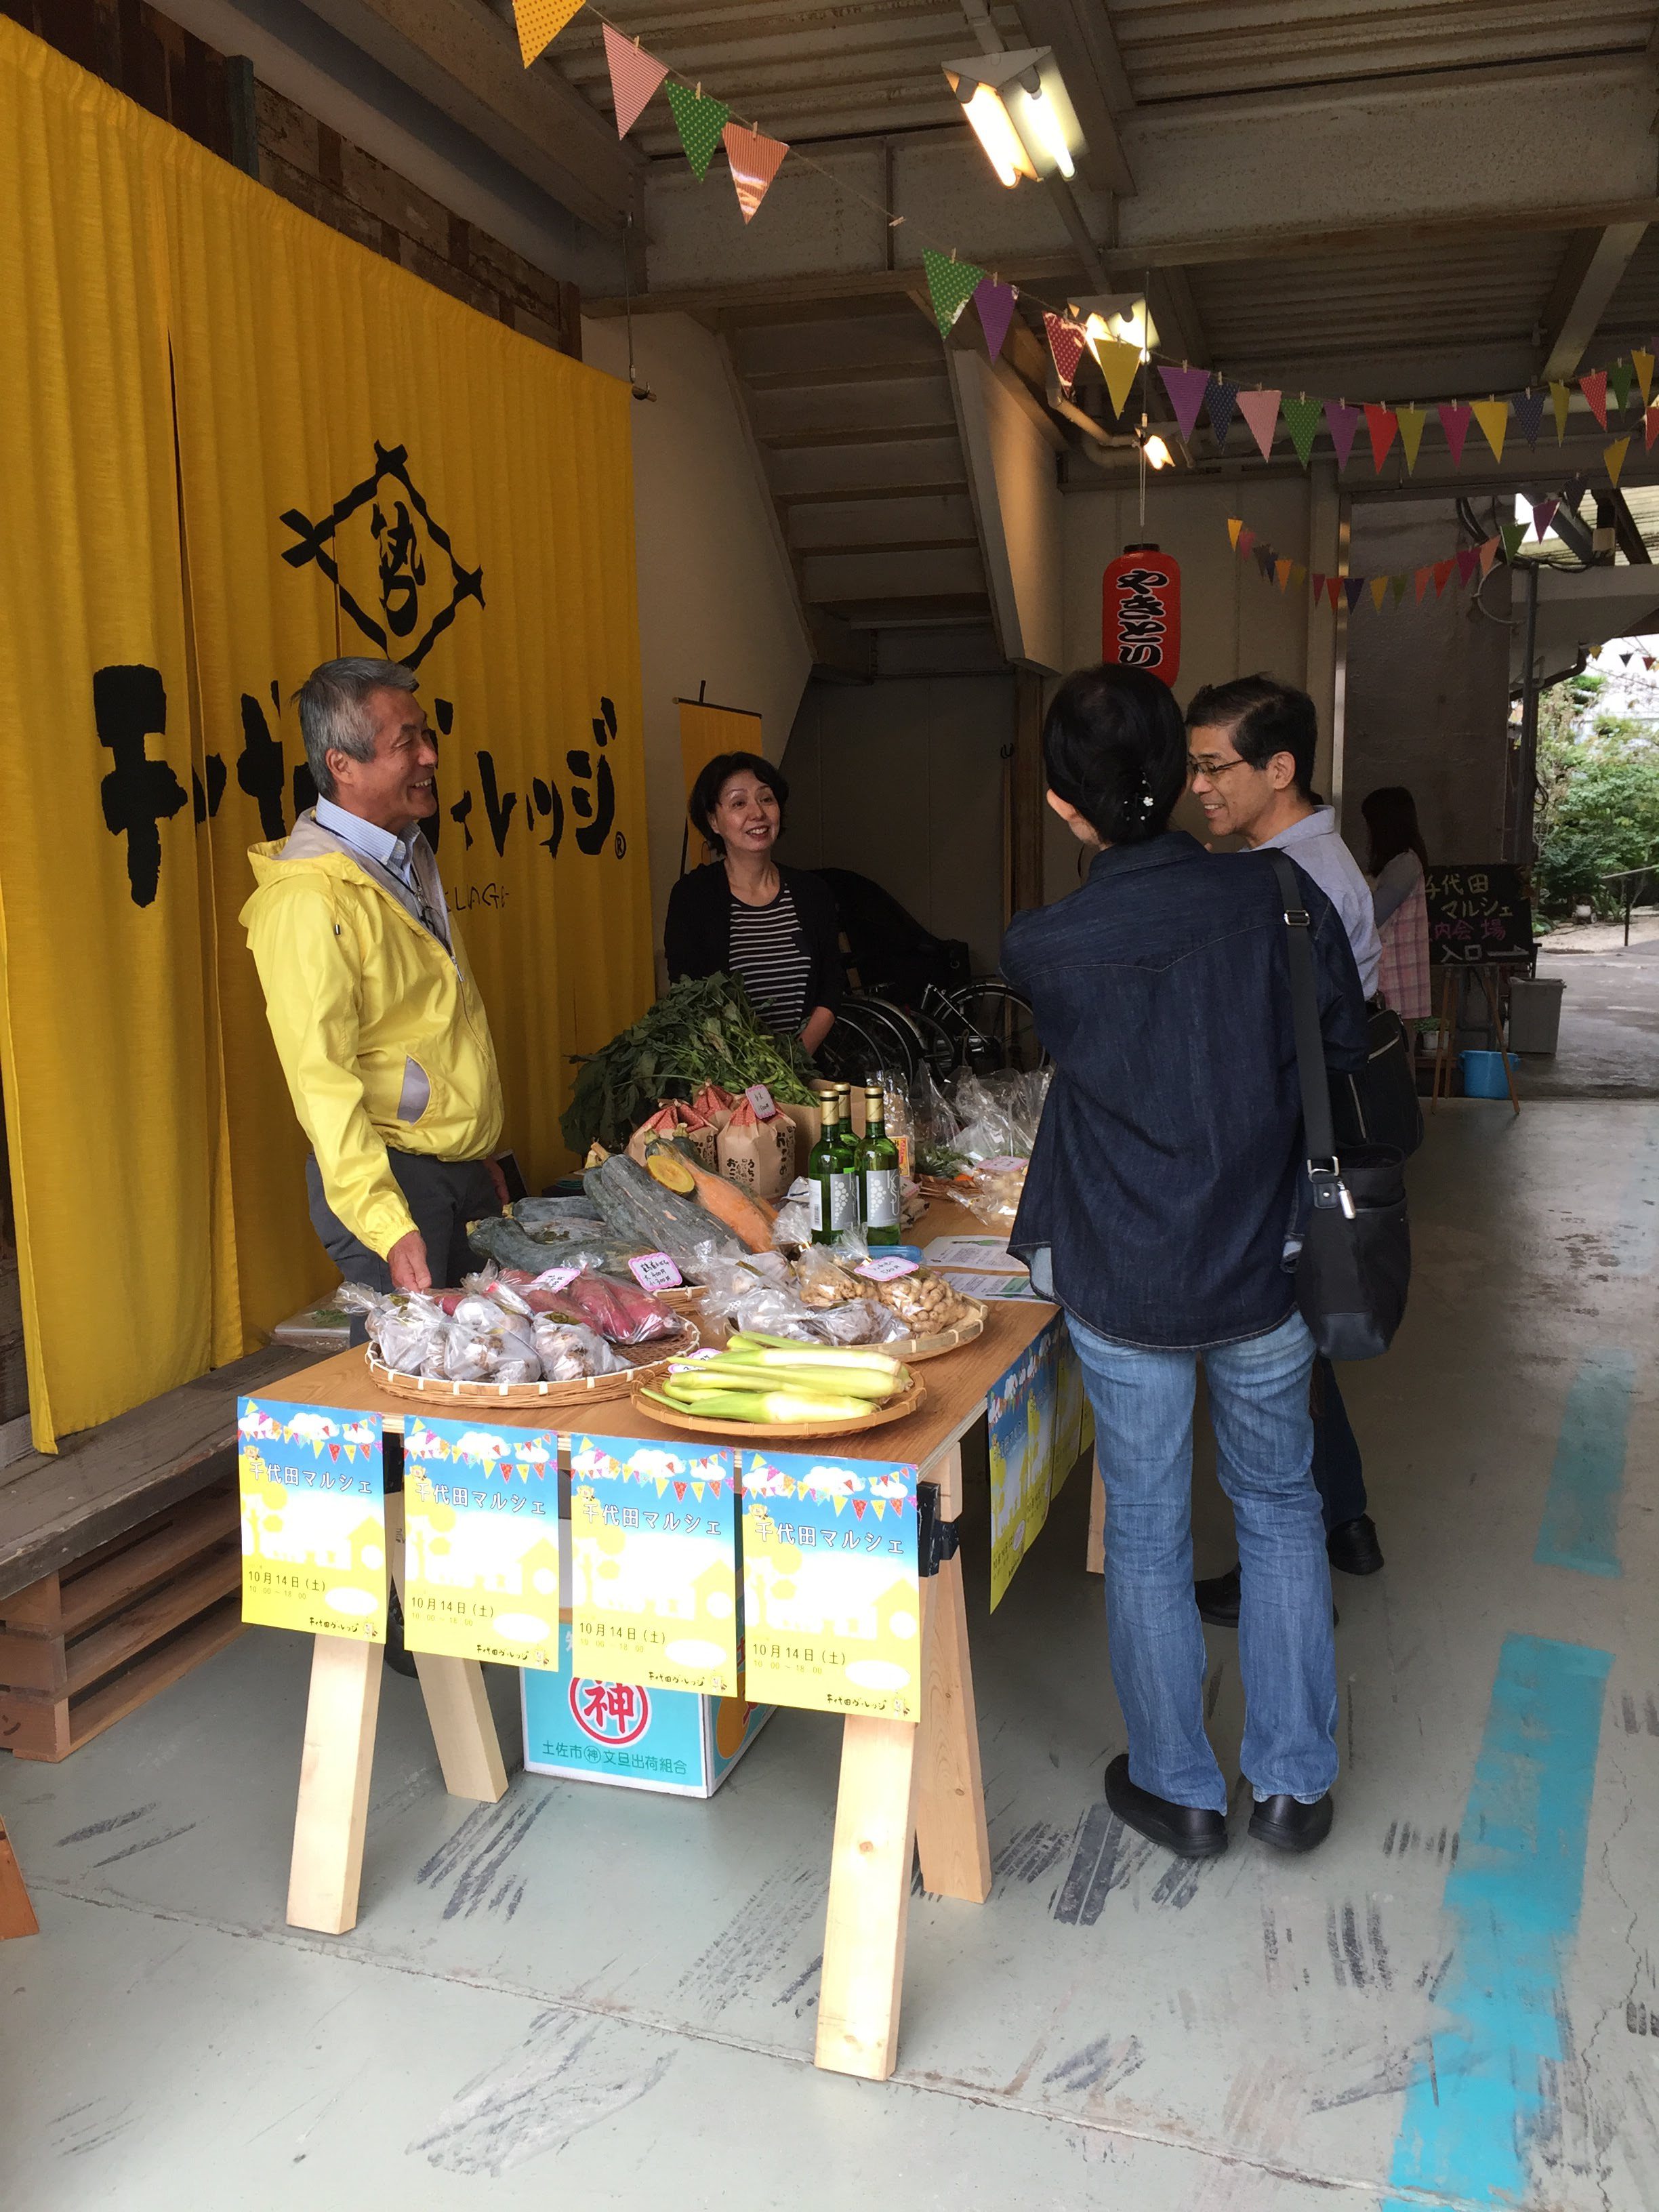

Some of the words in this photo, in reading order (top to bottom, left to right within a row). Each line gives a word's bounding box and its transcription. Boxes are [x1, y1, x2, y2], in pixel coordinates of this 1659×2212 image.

[1116, 568, 1170, 668] やきとり
[1425, 874, 1489, 900] 千代田
[1441, 897, 1513, 919] マルシェ
[1441, 944, 1483, 963] 入口
[249, 1462, 372, 1494] 千代田マルシェ
[415, 1482, 546, 1515] 千代田マルシェ
[582, 1503, 722, 1536] 千代田マルシェ
[754, 1521, 905, 1554] 千代田マルシェ
[583, 1678, 634, 1734] 神
